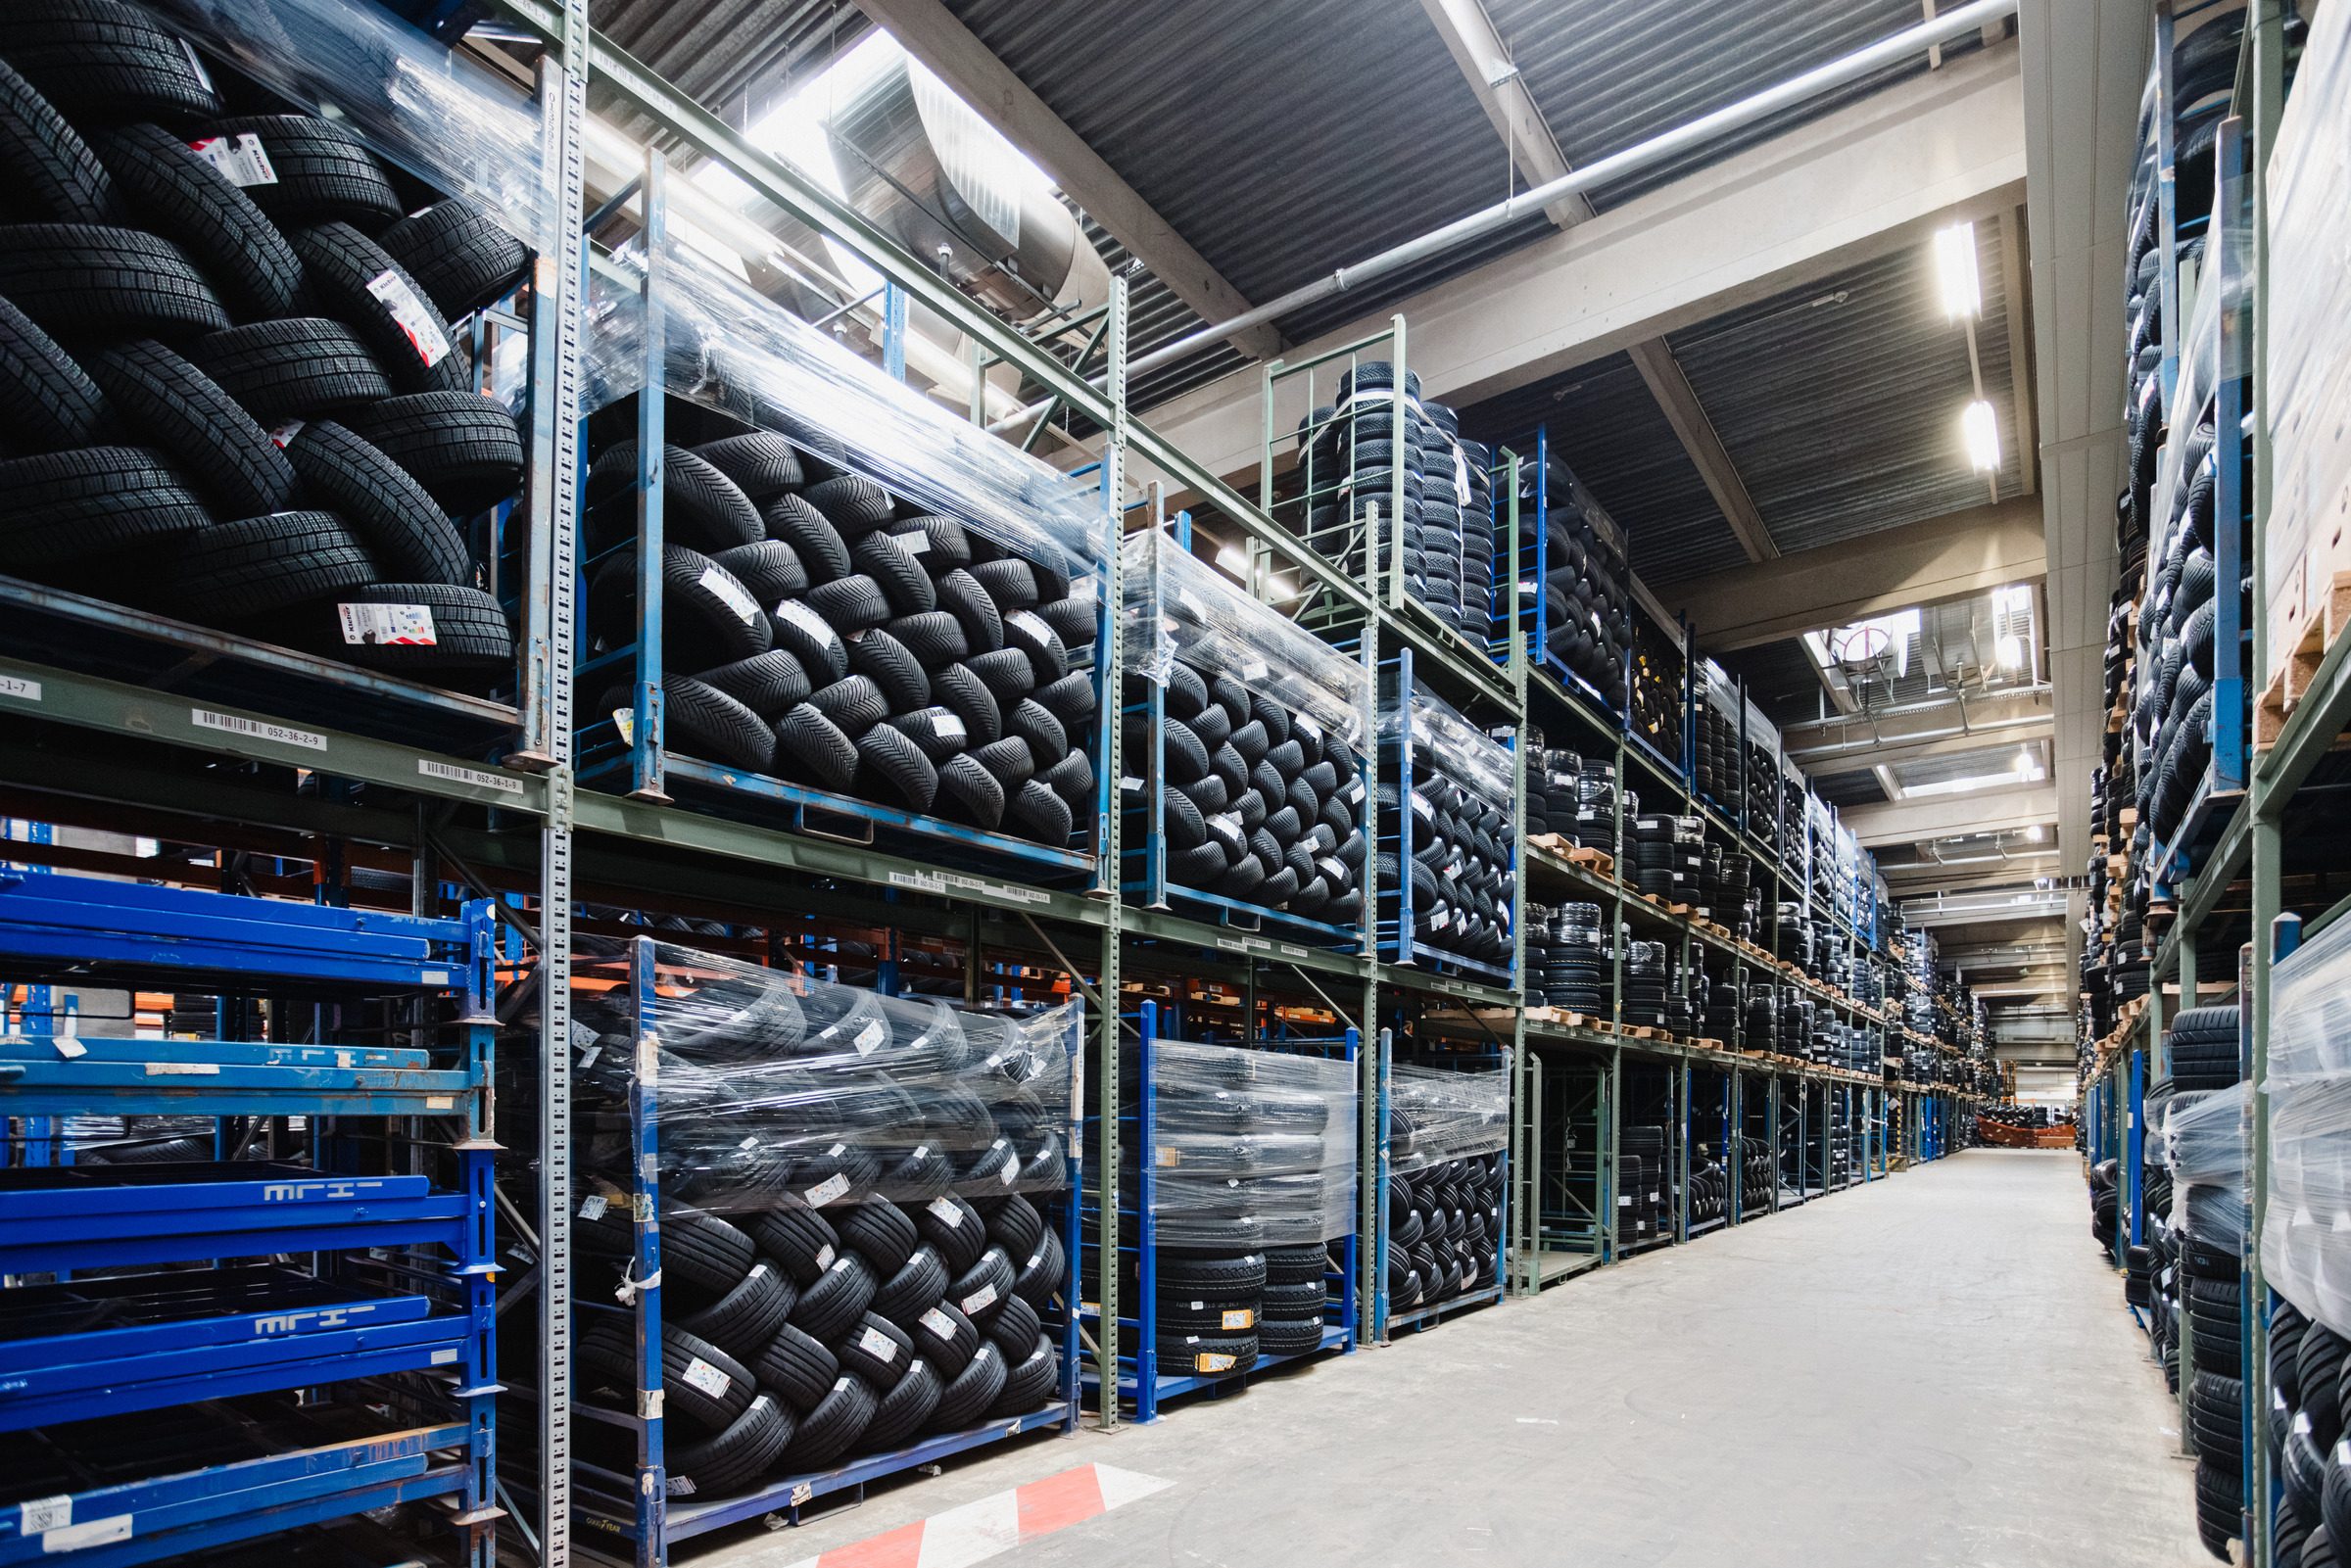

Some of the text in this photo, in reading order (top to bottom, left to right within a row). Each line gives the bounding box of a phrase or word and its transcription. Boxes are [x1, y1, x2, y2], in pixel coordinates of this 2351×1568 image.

[253, 150, 270, 180] Kleber
[379, 275, 396, 290] Kleber
[345, 605, 355, 632] Kleber
[267, 727, 318, 745] 052-36-2-9
